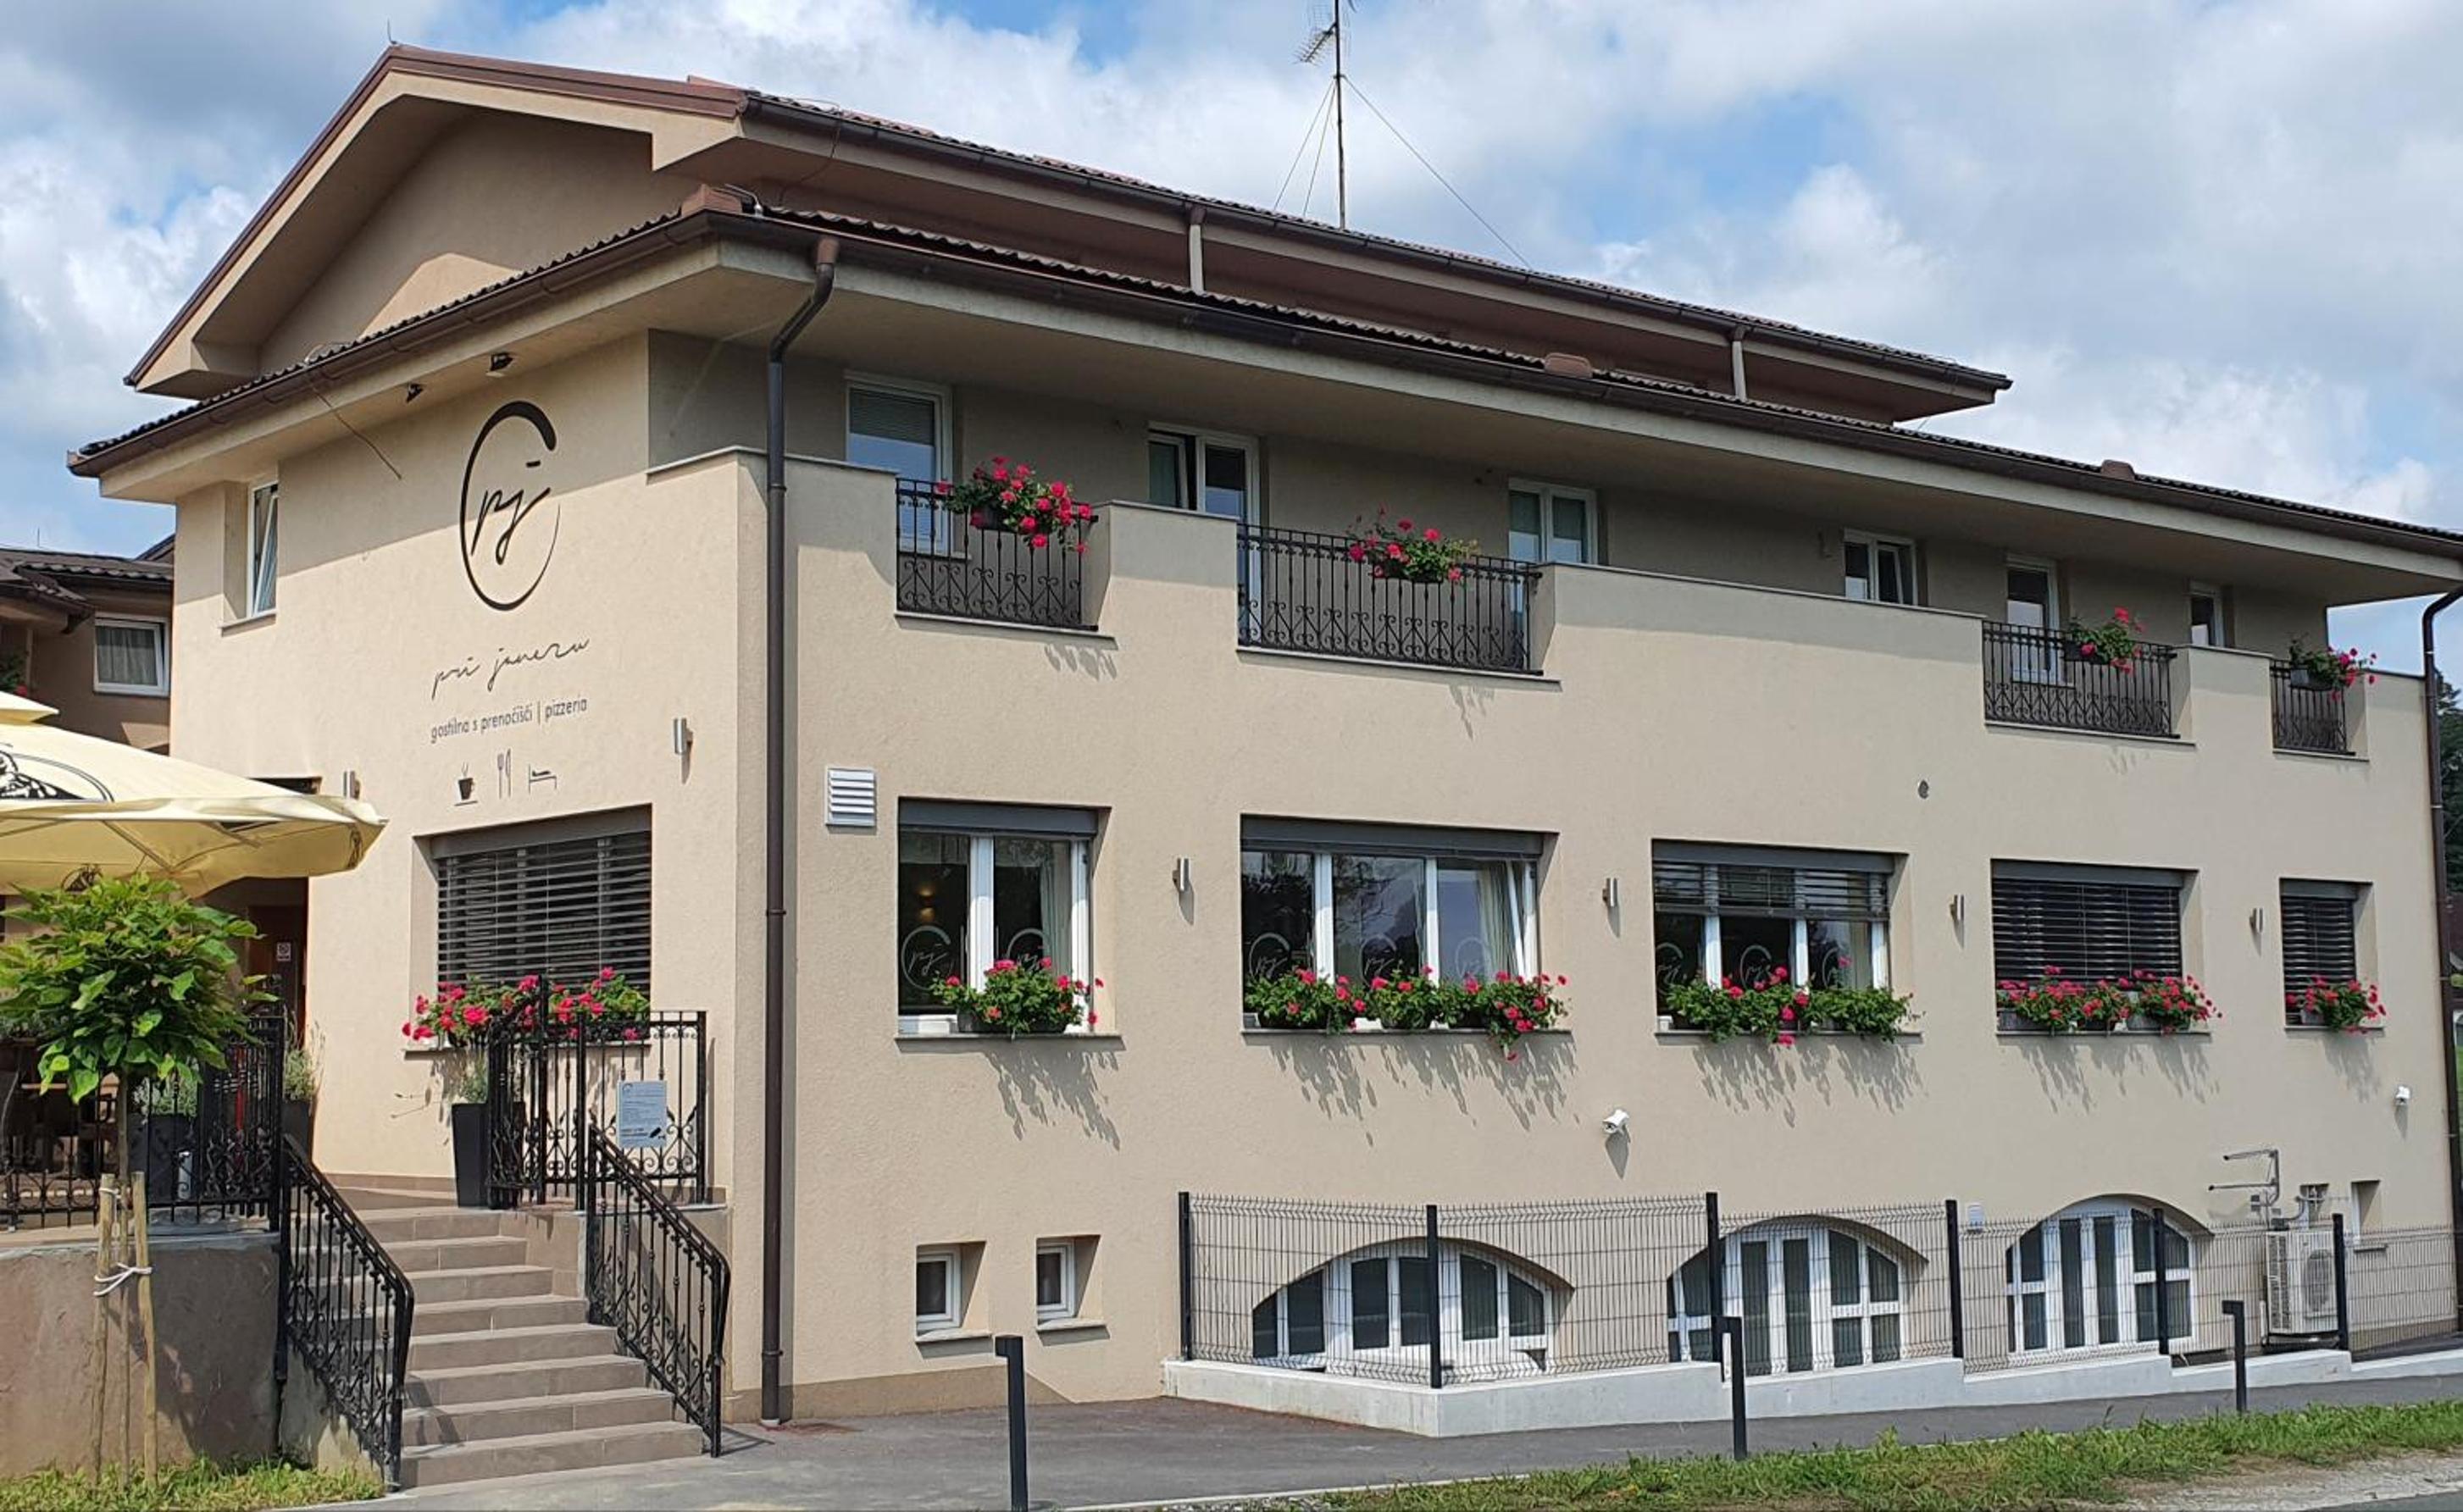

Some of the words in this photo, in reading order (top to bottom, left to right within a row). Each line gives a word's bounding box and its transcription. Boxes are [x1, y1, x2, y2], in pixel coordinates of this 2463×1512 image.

[430, 656, 480, 701] pri
[430, 717, 469, 744] gostilna
[473, 721, 478, 732] s
[545, 694, 587, 723] pizzeria
